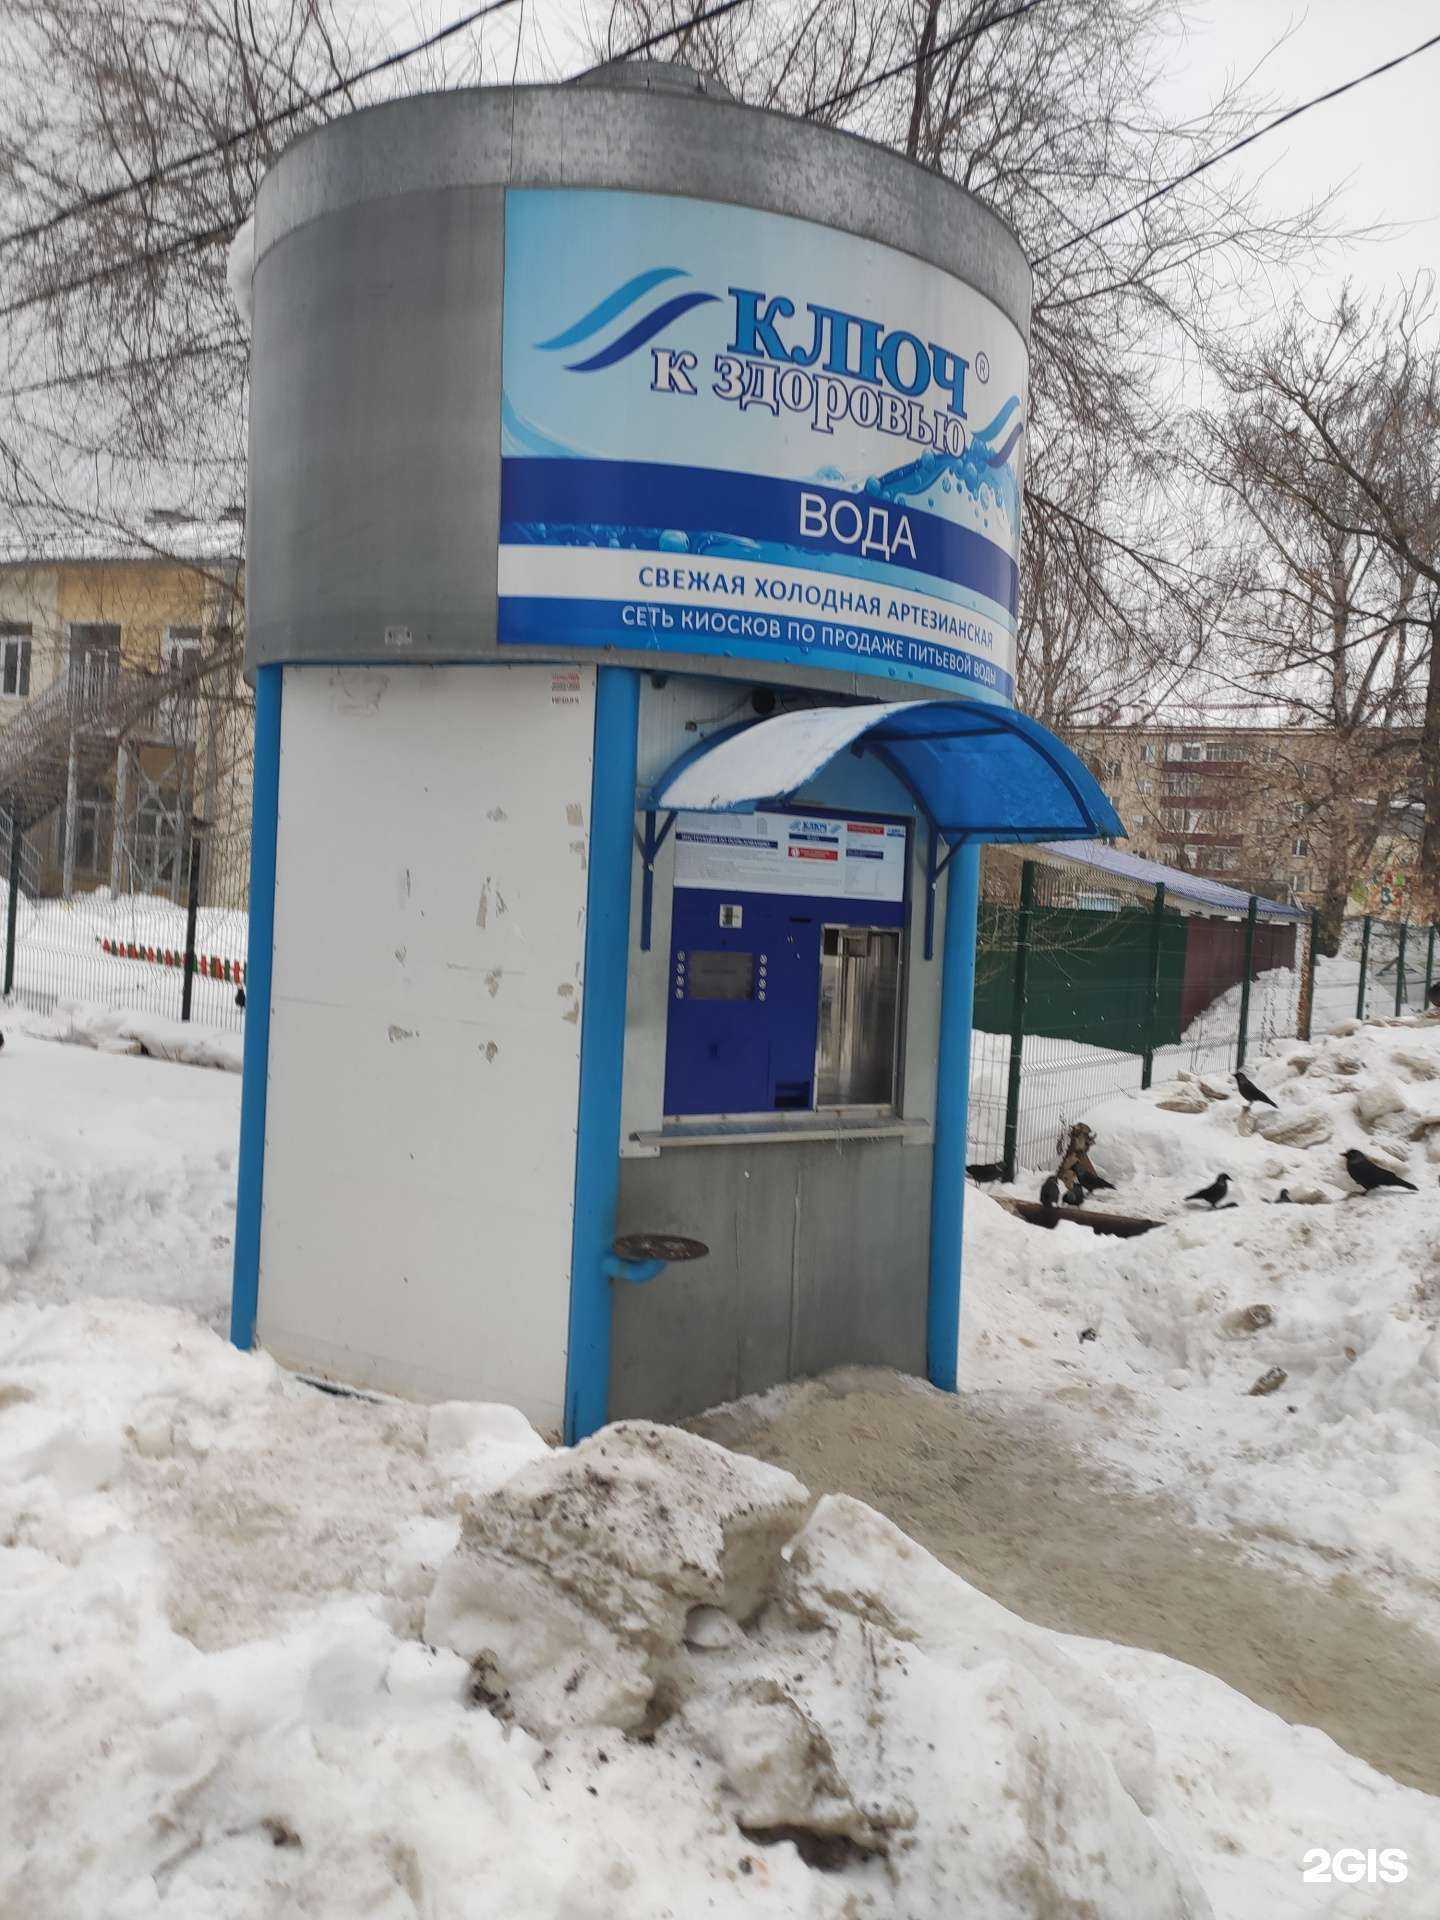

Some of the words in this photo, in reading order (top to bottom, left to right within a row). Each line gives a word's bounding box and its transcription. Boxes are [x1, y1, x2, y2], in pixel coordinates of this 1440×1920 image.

[727, 286, 970, 420] КЛЮЧ
[800, 492, 917, 561] ВОДА
[621, 604, 675, 629] СЕТЬ
[681, 608, 781, 639] КИОСКОВ
[787, 621, 815, 644] ПО
[822, 625, 903, 658] ПРОДАЖЕ
[908, 643, 971, 674] ПИТЬЕВОЙ
[973, 660, 997, 687] ВОДЫ
[638, 567, 745, 596] СВЕЖАЯ
[755, 577, 880, 616] ХОЛОДНАЯ
[887, 600, 993, 650] АРТЕЗИАНСКАЯ
